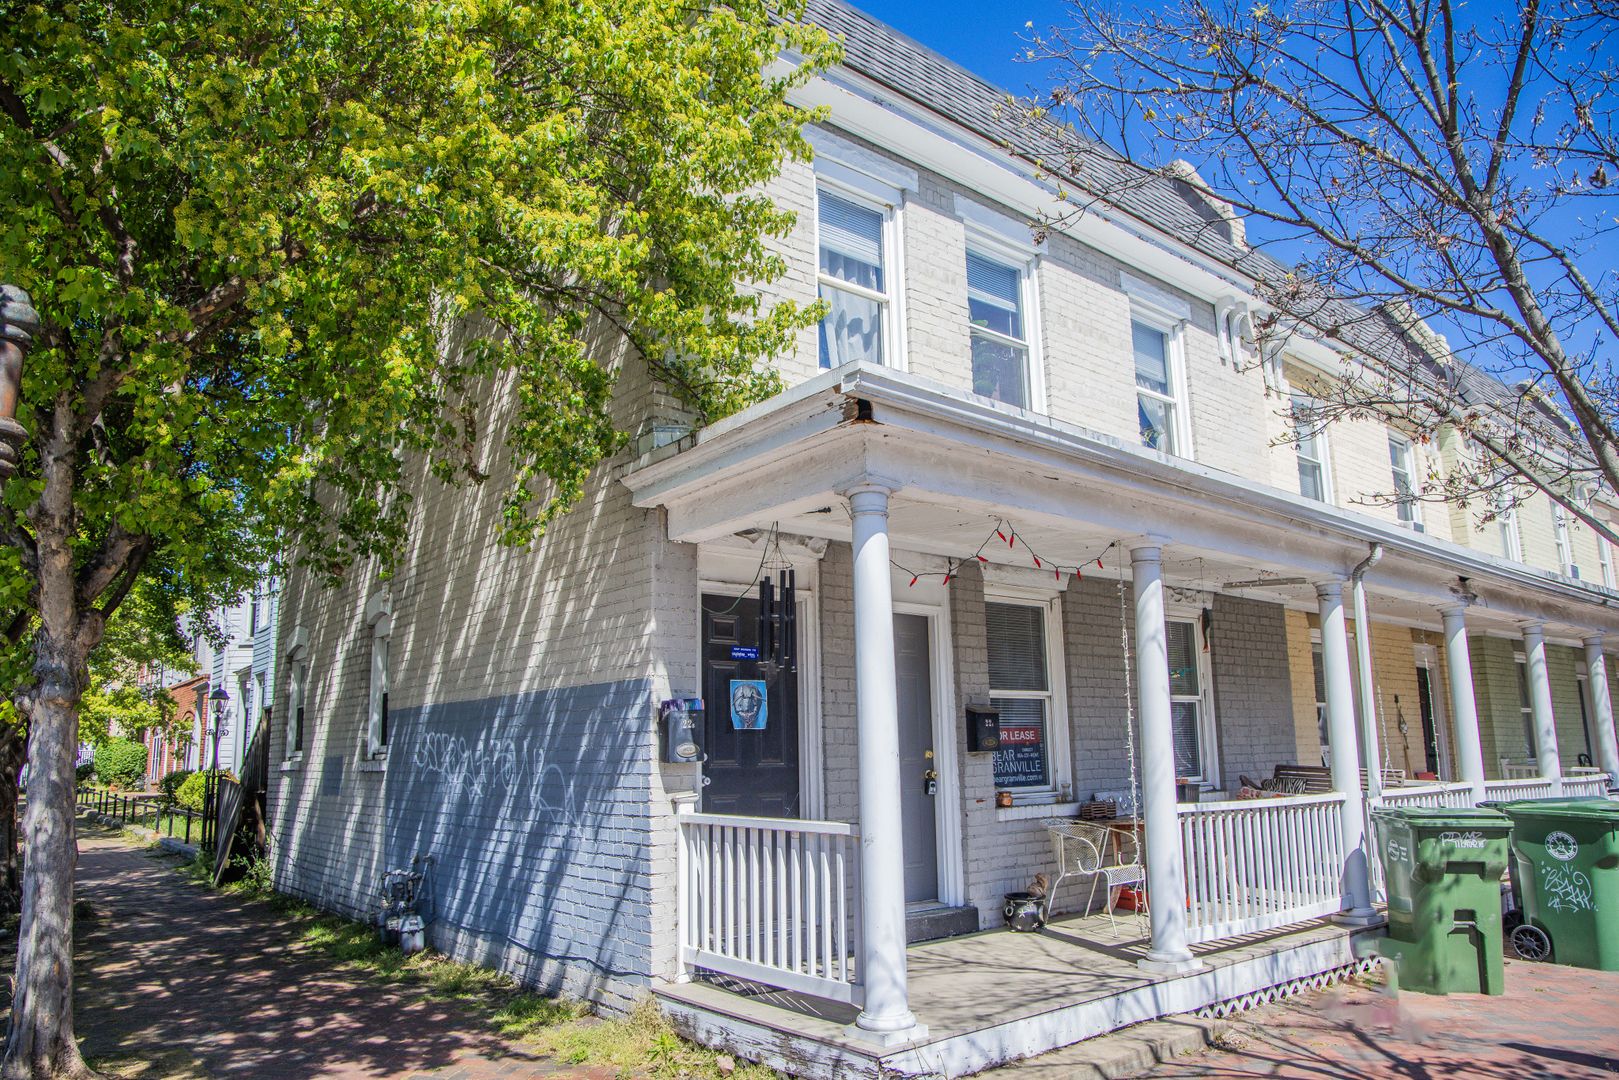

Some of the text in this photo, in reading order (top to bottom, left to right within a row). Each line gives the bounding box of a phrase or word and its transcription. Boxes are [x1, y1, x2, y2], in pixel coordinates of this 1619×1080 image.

[999, 731, 1036, 740] OR LEASE
[992, 749, 1015, 762] BEAR
[993, 760, 1041, 774] GRANVILLE
